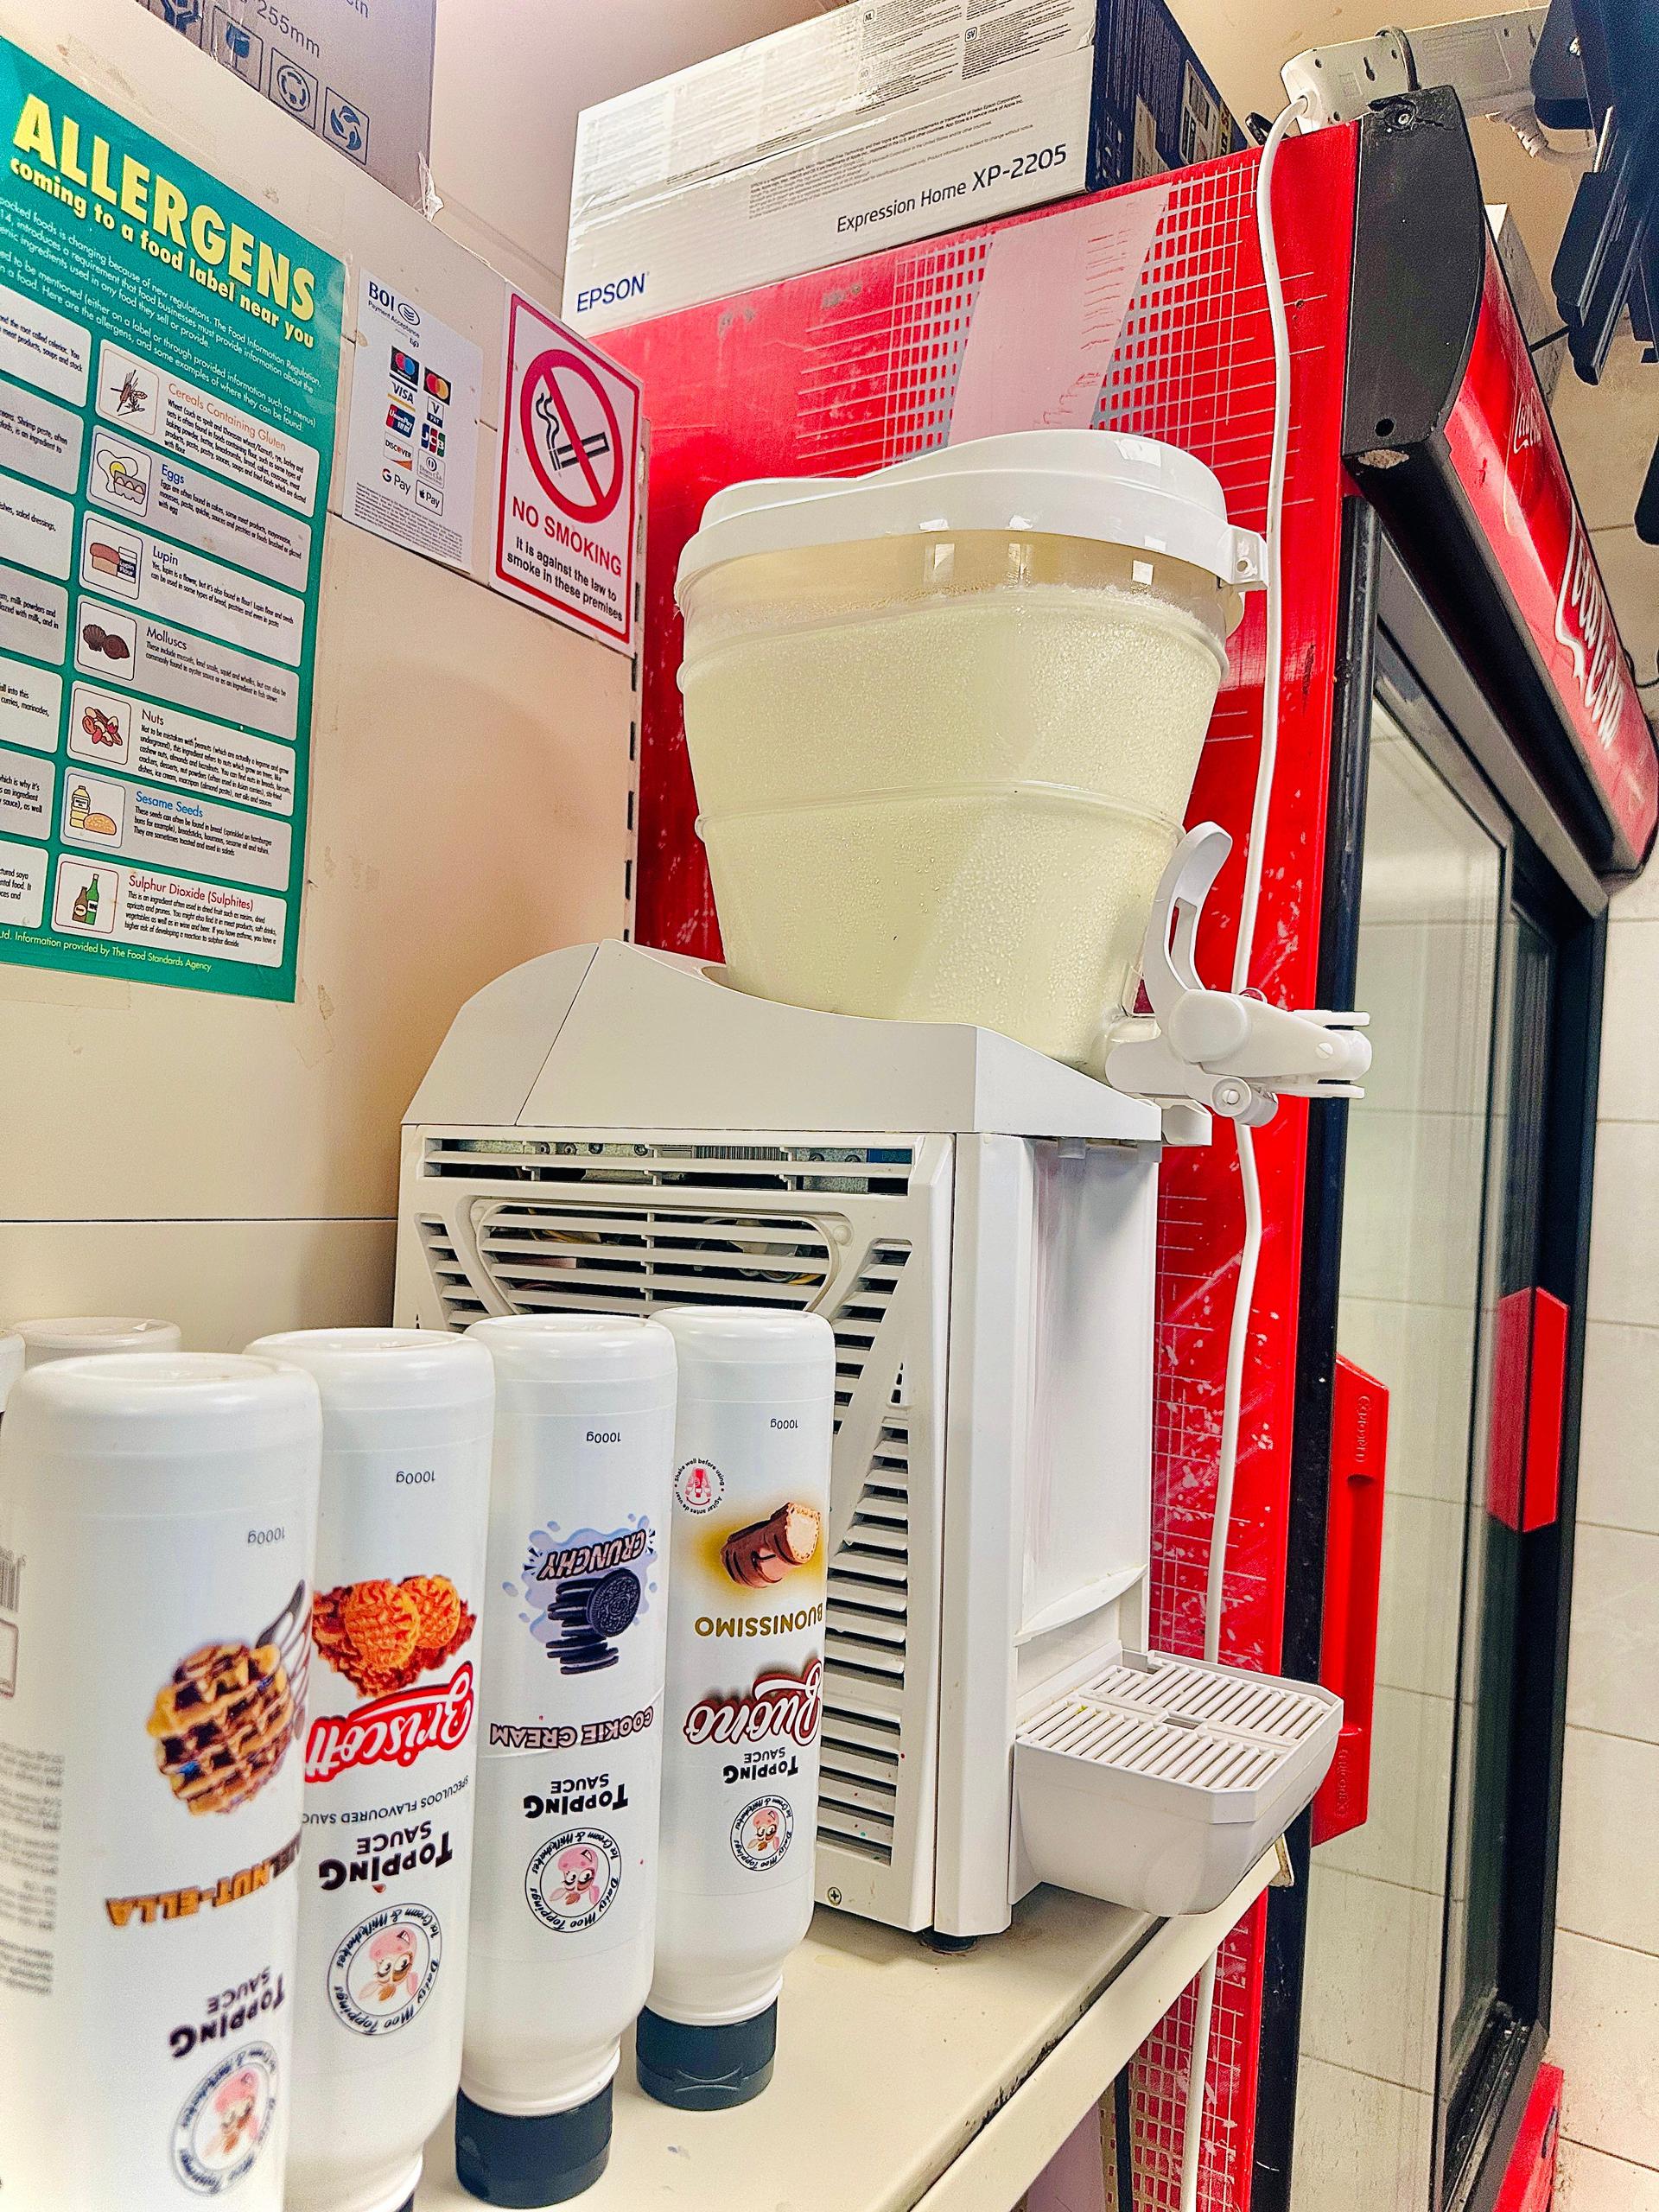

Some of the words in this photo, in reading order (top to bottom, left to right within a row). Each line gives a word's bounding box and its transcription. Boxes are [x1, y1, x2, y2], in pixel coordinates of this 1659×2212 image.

[257, 0, 321, 58] 255mm
[836, 195, 916, 233] Expression
[920, 180, 967, 207] Home
[971, 143, 1067, 191] XP-2205
[12, 93, 315, 321] ALLERGENS
[10, 157, 86, 219] coming
[94, 203, 114, 230] to
[121, 224, 133, 242] a
[141, 230, 183, 270] food
[189, 258, 235, 301] label
[240, 295, 279, 327] near
[284, 321, 313, 349] you
[16, 218, 60, 251] introduces
[72, 252, 119, 283] requirement
[121, 277, 137, 293] that
[138, 286, 156, 304] food
[157, 297, 195, 327] businesses
[197, 324, 213, 338] must
[215, 334, 242, 354] provide
[244, 347, 282, 376] information
[283, 371, 302, 387] about
[303, 381, 313, 394] the
[20, 234, 67, 269] ingredients
[70, 265, 89, 281] used
[92, 275, 99, 286] in
[100, 283, 116, 297] any
[118, 288, 137, 307] food
[138, 301, 155, 319] they
[156, 313, 168, 325] sell
[170, 321, 179, 331] or
[180, 327, 210, 348] provide.
[33, 212, 56, 234] foods
[60, 228, 67, 240] is
[68, 234, 106, 265] changing
[108, 255, 139, 283] because
[142, 277, 150, 289] of
[151, 284, 168, 297] new
[169, 296, 212, 324] regulations.
[213, 317, 226, 332] The
[227, 326, 245, 343] Food
[247, 337, 284, 365] Information
[286, 359, 321, 387] Regulation,
[369, 281, 394, 311] BOI
[576, 272, 645, 312] EPSON
[14, 257, 22, 268] to
[24, 259, 35, 275] be
[38, 271, 82, 300] mentioned
[85, 293, 110, 315] (either
[111, 312, 122, 322] on
[132, 318, 150, 338] label
[152, 334, 162, 343] or
[163, 337, 192, 359] through
[194, 356, 226, 378] provided
[227, 372, 266, 399] information
[267, 396, 283, 409] such
[283, 405, 291, 414] as
[293, 410, 315, 428] menus)
[16, 270, 39, 291] food.
[41, 284, 63, 303] Here
[65, 300, 79, 313] are
[81, 306, 93, 321] the
[96, 315, 134, 343] allergens,
[136, 338, 152, 351] and
[154, 347, 173, 362] some
[175, 359, 209, 382] examples
[211, 377, 219, 386] of
[220, 382, 241, 399] where
[243, 392, 257, 409] they
[258, 404, 271, 415] can
[272, 407, 282, 421] be
[391, 381, 413, 404] VISA
[431, 401, 439, 414] V
[168, 383, 203, 409] Cereals
[207, 403, 255, 438] Containing
[257, 429, 286, 451] Gluten
[389, 409, 412, 428] UnionPay
[385, 439, 411, 458] DISCOVER
[162, 464, 184, 485] Eggs
[393, 474, 410, 495] Pay
[425, 492, 440, 508] Pay
[512, 496, 538, 527] NO
[544, 516, 621, 575] SMOKING
[153, 545, 178, 565] Lupin
[525, 541, 534, 556] is
[537, 551, 571, 577] against
[574, 569, 588, 586] the
[591, 578, 605, 595] law
[607, 588, 616, 601] to
[507, 552, 540, 577] smoke
[543, 569, 551, 583] in
[555, 575, 580, 599] these
[582, 593, 622, 621] premises
[146, 626, 187, 650] Molluscs
[142, 709, 164, 725] Nuts
[136, 791, 173, 810] Sesame
[175, 801, 203, 817] Seeds
[129, 874, 166, 892] Sulphur
[168, 883, 205, 900] Dioxide
[207, 891, 253, 912] (Sulphites)
[15, 931, 60, 947] Information
[63, 942, 98, 953] provided
[99, 944, 110, 957] by
[111, 946, 125, 957] The
[127, 949, 146, 960] Food
[148, 952, 183, 966] Standards
[586, 1431, 621, 1444] 1000g
[769, 1418, 798, 1430] 1000g
[396, 1470, 435, 1485] 1000g
[675, 1465, 685, 1482] Shake
[698, 1458, 716, 1470] before
[715, 1470, 724, 1485] using
[247, 1527, 285, 1544] 1000g
[537, 1528, 647, 1580] CRUNCHY
[694, 1602, 823, 1638] BUONISSIMO
[490, 1722, 578, 1749] CREAM
[581, 1706, 654, 1746] COOKIE
[722, 1755, 798, 1784] TOPPING
[743, 1746, 785, 1764] SAUCE
[420, 1774, 469, 1808] SPECULOOS
[550, 1772, 610, 1794] SAUCE
[340, 1800, 417, 1824] FLAVOURED
[523, 1783, 629, 1819] TOPPING
[302, 1814, 337, 1825] SAUC
[356, 1820, 432, 1855] SAUCE
[575, 1832, 586, 1842] &
[588, 1832, 613, 1848] Cream
[319, 1830, 453, 1891] TOPPING
[532, 1834, 573, 1874] Milkshakes
[610, 1847, 619, 1859] Ice
[391, 1910, 402, 1922] &
[405, 1909, 433, 1926] Cream
[530, 1888, 566, 1930] Toppings
[570, 1911, 596, 1928] Moo
[336, 1913, 387, 1968] Milkshakes
[206, 1966, 270, 2015] SAUCE
[168, 1972, 286, 2062] TOPPING
[334, 1986, 378, 2034] Toppings
[384, 2005, 414, 2029] Moo
